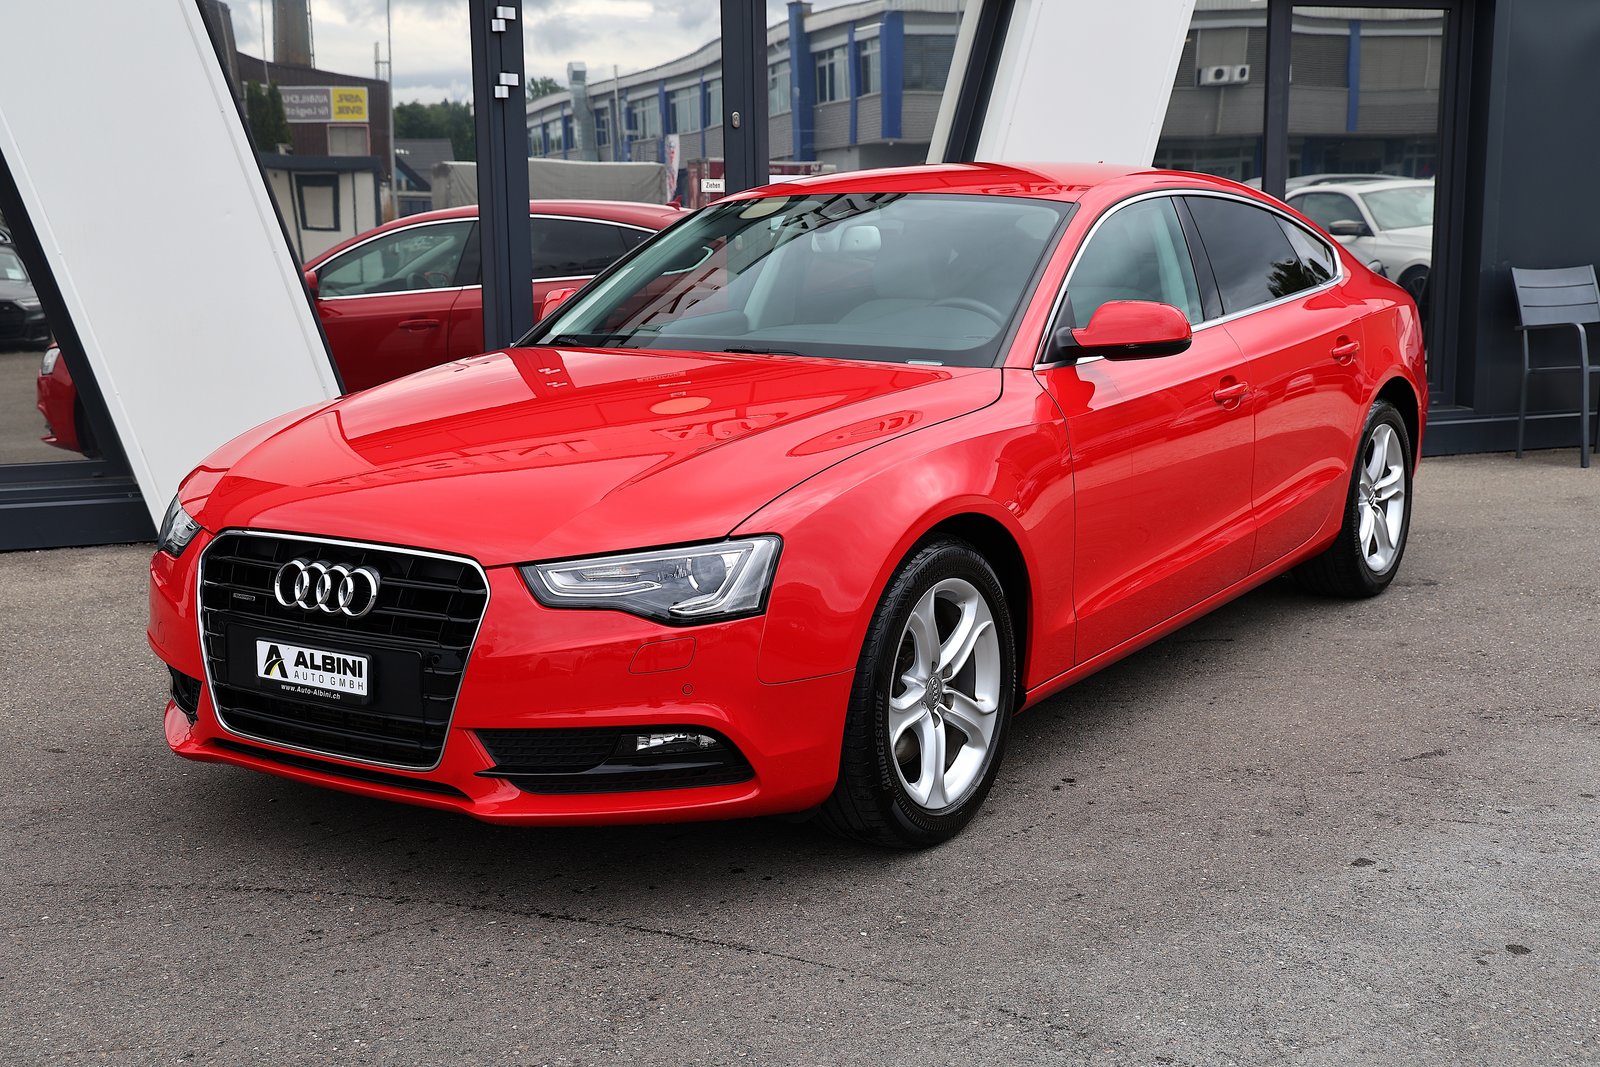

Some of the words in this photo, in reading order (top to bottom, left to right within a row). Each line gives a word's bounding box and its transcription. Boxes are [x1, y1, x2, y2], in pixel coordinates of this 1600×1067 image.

[705, 181, 721, 189] Ziehen
[294, 651, 363, 678] ALBINI
[294, 670, 324, 684] AUTO
[331, 676, 364, 691] GMBH
[281, 684, 341, 700] www.Auto-Albini.ch
[875, 690, 893, 790] BRIDGESTONE
